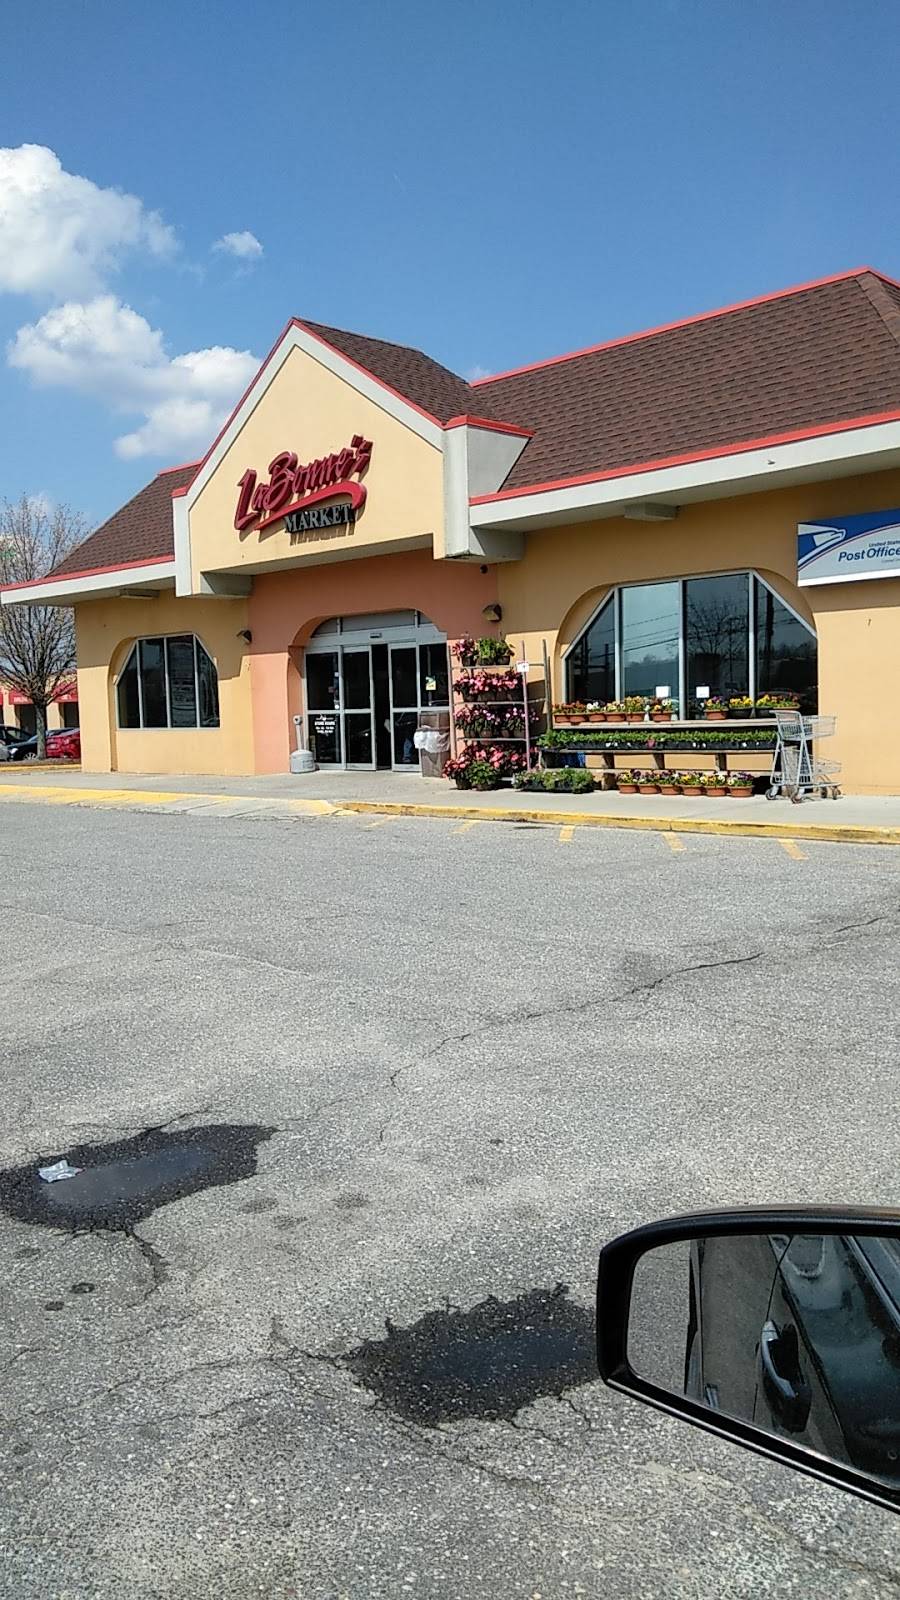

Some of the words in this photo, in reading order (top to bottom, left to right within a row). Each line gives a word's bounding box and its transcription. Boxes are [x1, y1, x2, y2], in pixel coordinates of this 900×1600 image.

[234, 434, 374, 531] LaBonne's
[284, 503, 353, 533] MARKET
[838, 549, 865, 562] Post
[866, 546, 900, 558] Office
